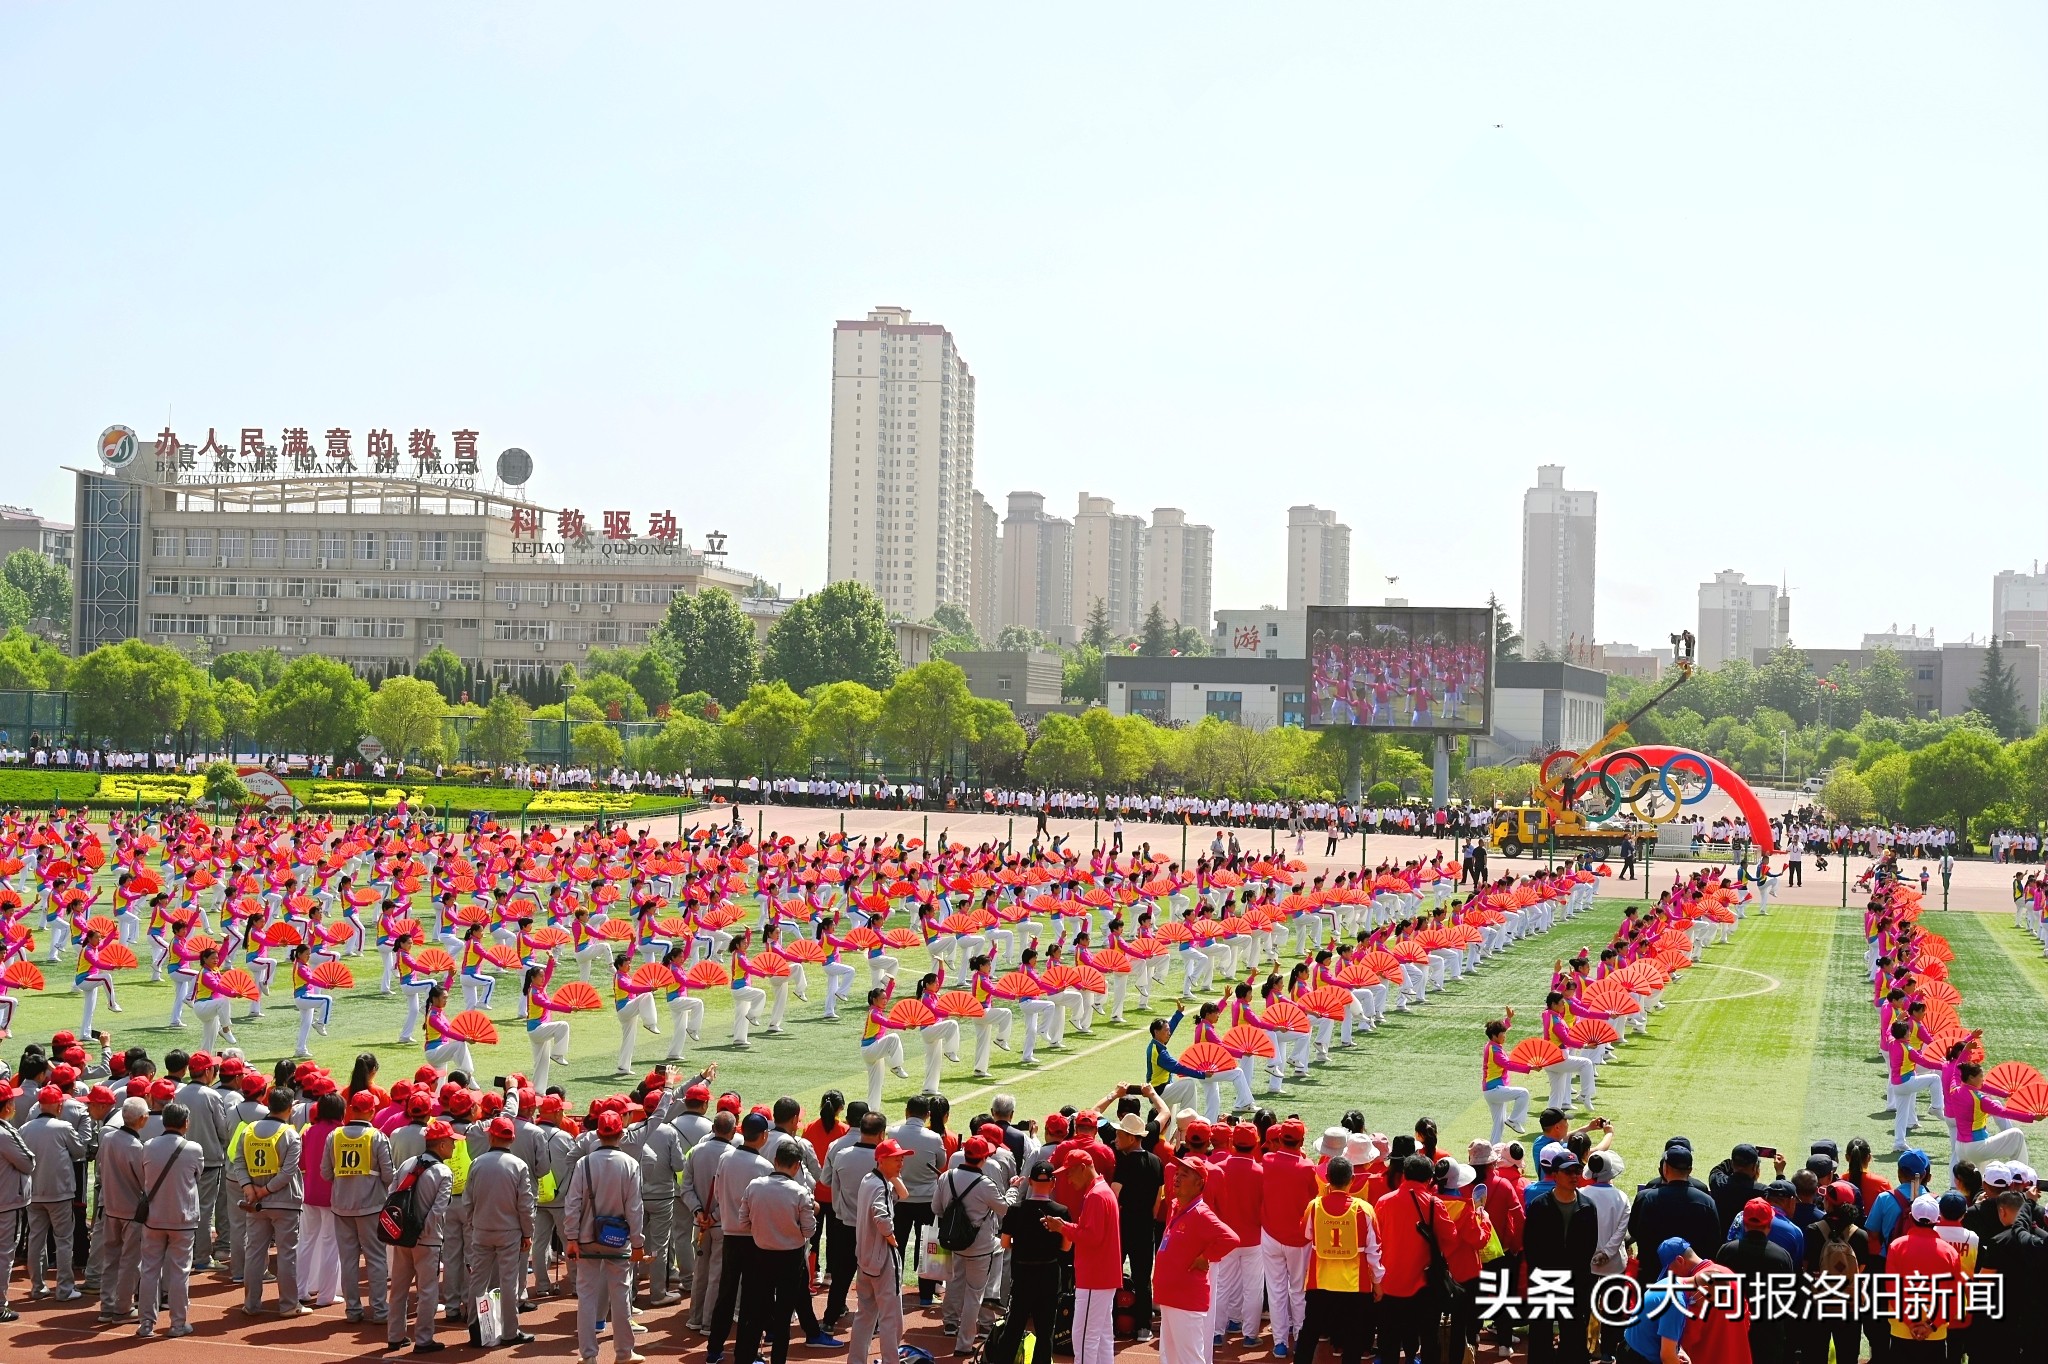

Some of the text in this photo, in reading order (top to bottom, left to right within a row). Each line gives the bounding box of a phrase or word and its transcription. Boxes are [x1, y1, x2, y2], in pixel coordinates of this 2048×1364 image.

[154, 427, 480, 459] 办人民满意的教育
[155, 461, 189, 473] BAN
[214, 461, 277, 474] RENMIN
[510, 508, 679, 540] 科教驱动
[511, 542, 673, 559] KEJIAO QUDONG
[254, 1149, 266, 1167] 8
[340, 1150, 361, 1168] 10
[1331, 1227, 1342, 1248] 1
